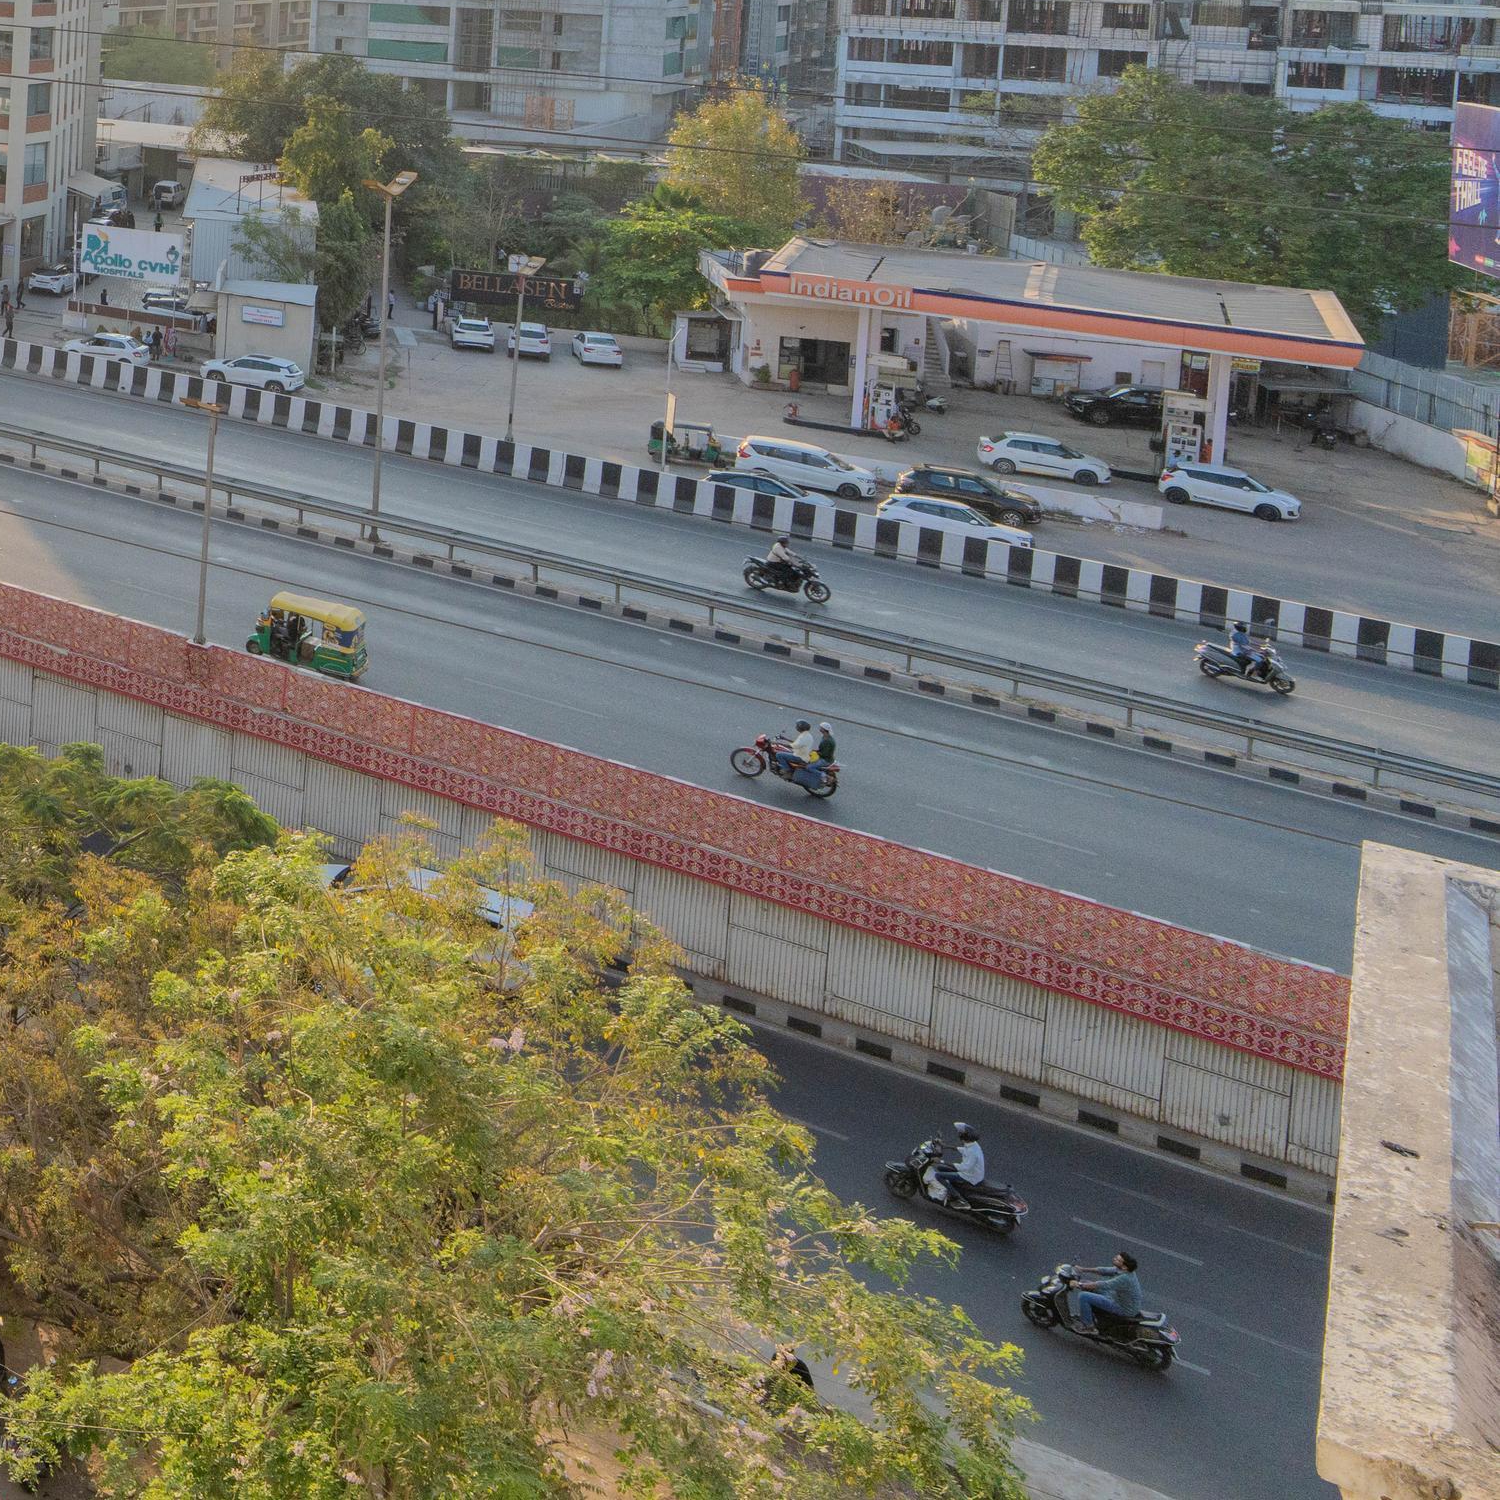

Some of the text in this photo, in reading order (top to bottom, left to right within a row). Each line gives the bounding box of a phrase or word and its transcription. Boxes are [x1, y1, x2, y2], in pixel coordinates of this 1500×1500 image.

[1455, 142, 1476, 177] FEEL
[1454, 179, 1482, 213] THRILL
[82, 249, 180, 275] Apollo CVHF
[97, 266, 144, 279] HOSPITALS
[790, 275, 911, 309] IndianOil
